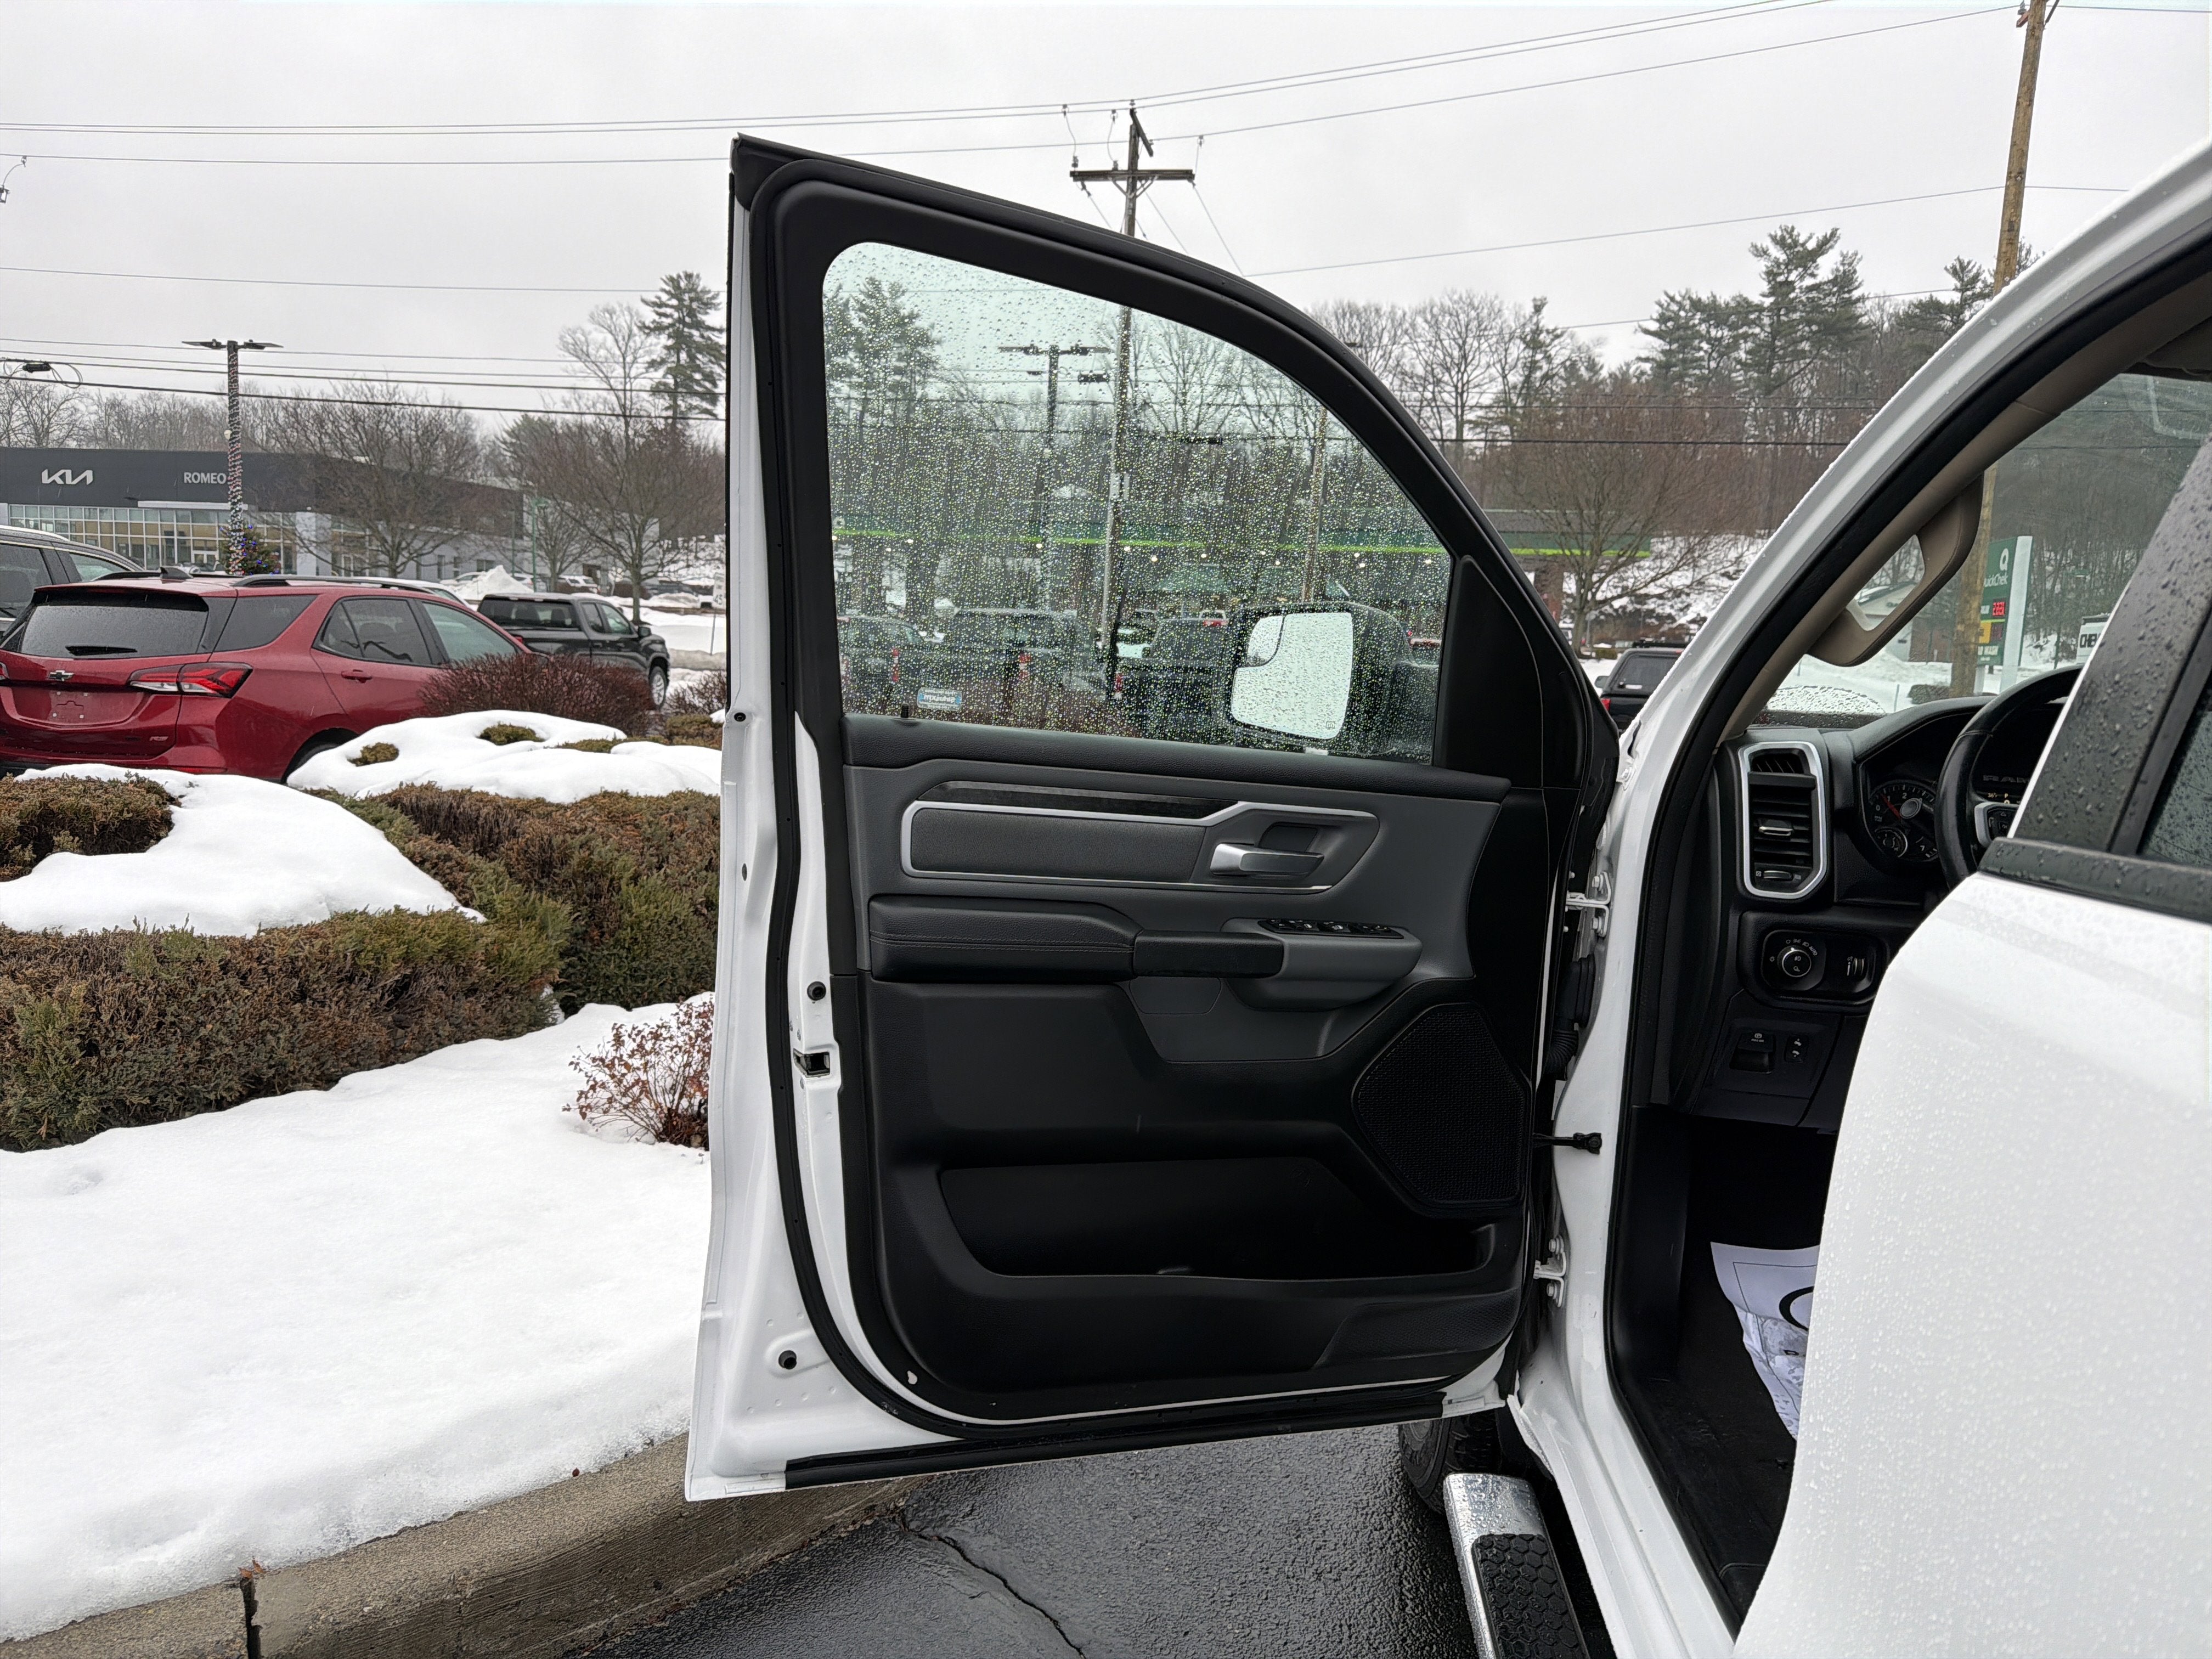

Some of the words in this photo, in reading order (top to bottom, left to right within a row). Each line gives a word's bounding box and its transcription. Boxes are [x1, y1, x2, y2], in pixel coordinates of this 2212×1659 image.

[42, 469, 93, 485] KIA
[184, 472, 227, 484] ROMEO
[1984, 572, 2008, 588] uickChek
[1809, 946, 1818, 956] AUTO
